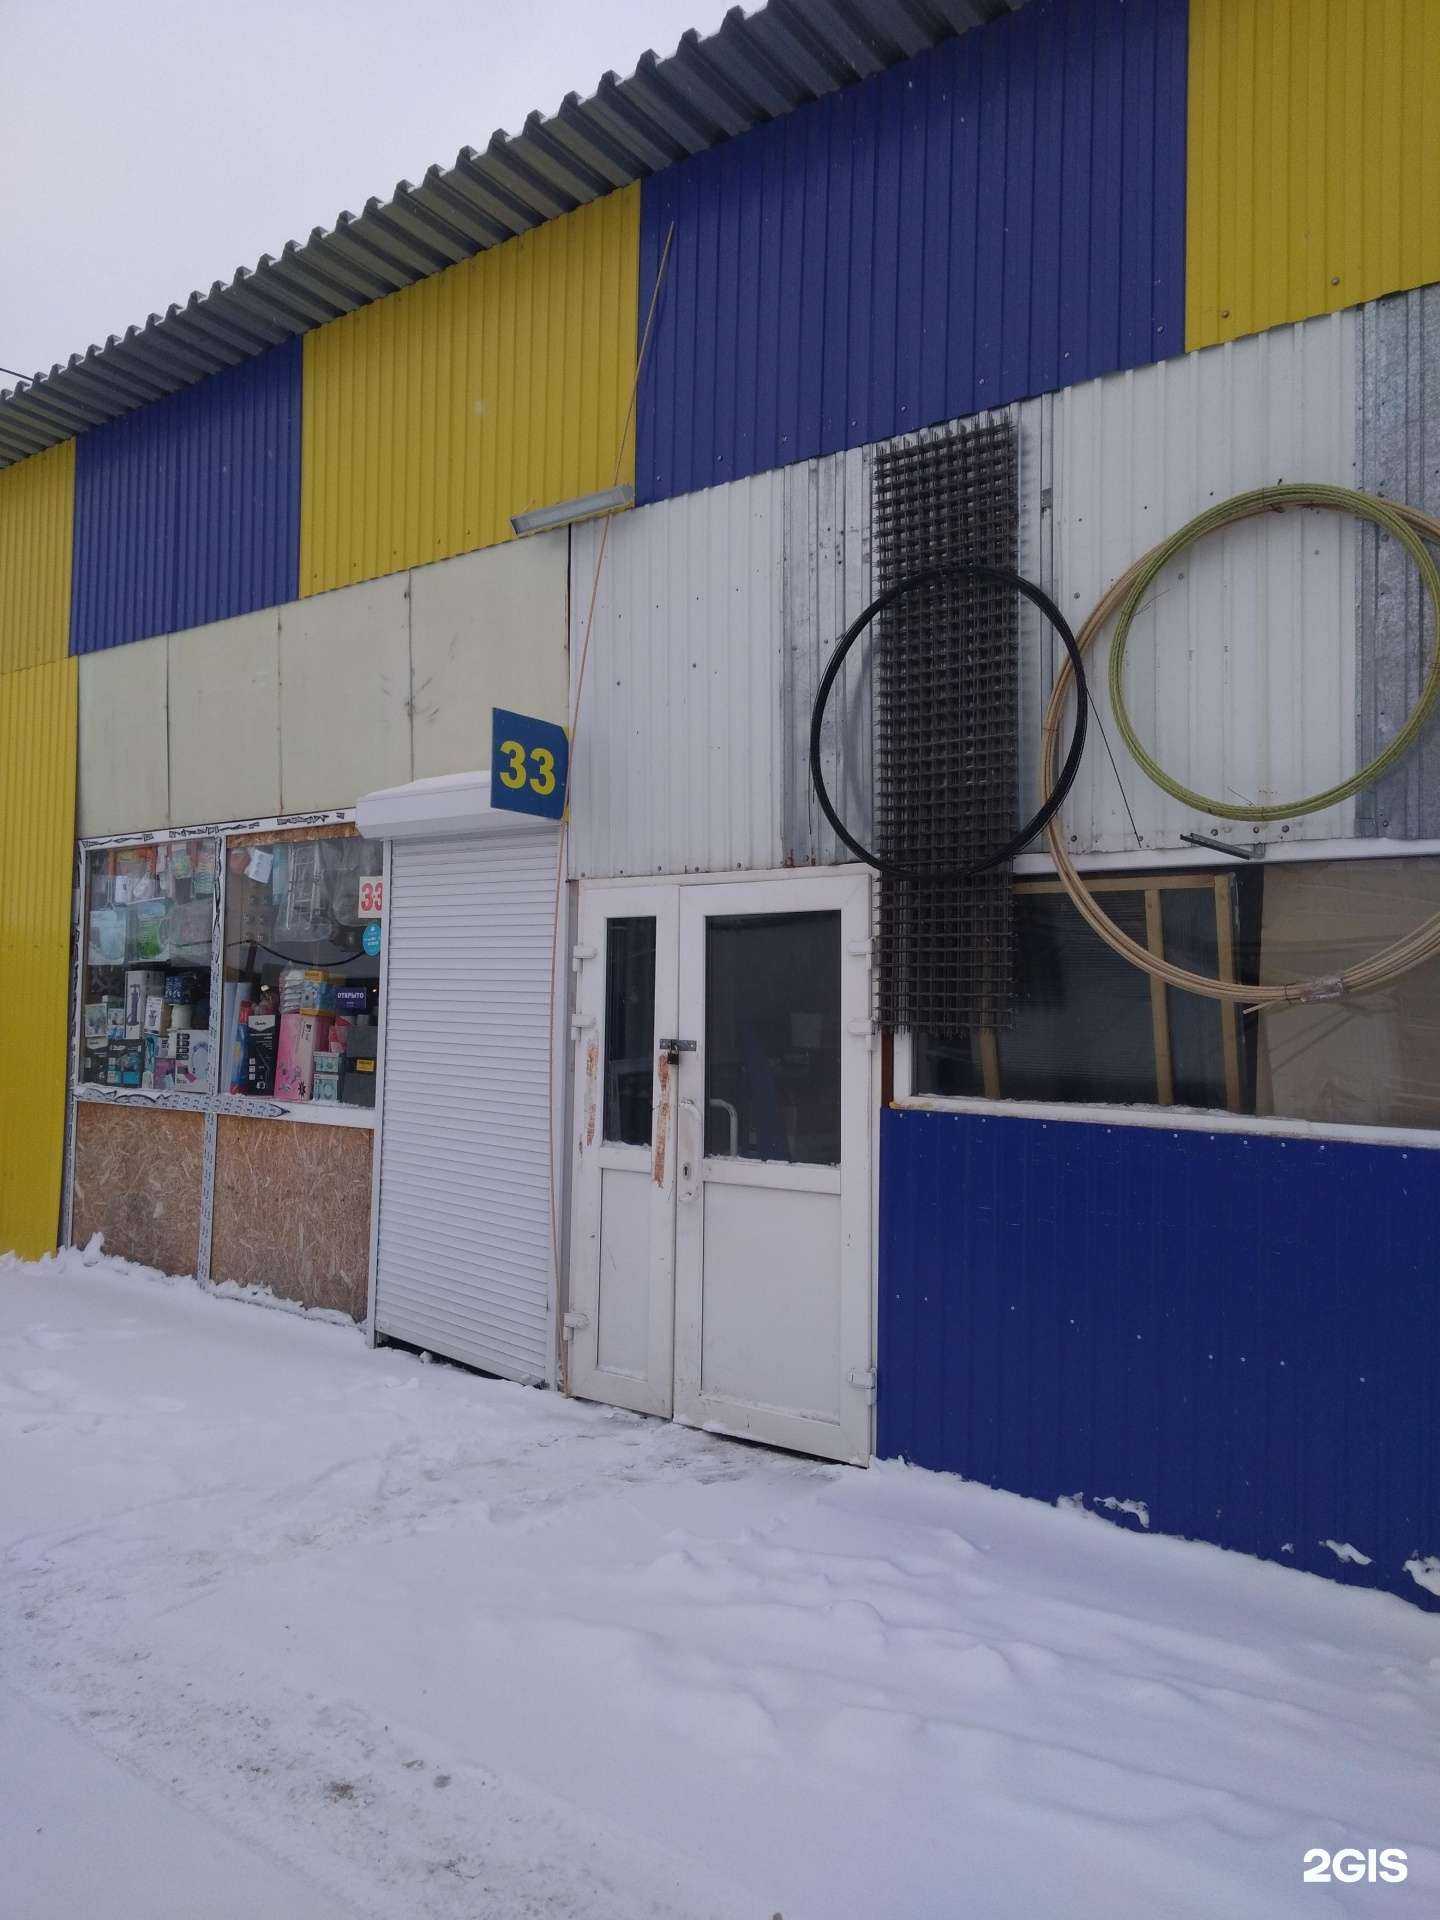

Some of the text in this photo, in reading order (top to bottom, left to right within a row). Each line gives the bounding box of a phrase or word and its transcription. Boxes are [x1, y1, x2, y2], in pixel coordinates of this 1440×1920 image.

[500, 740, 556, 796] 33
[360, 882, 384, 912] 33
[337, 991, 364, 999] ОТКРЫТО
